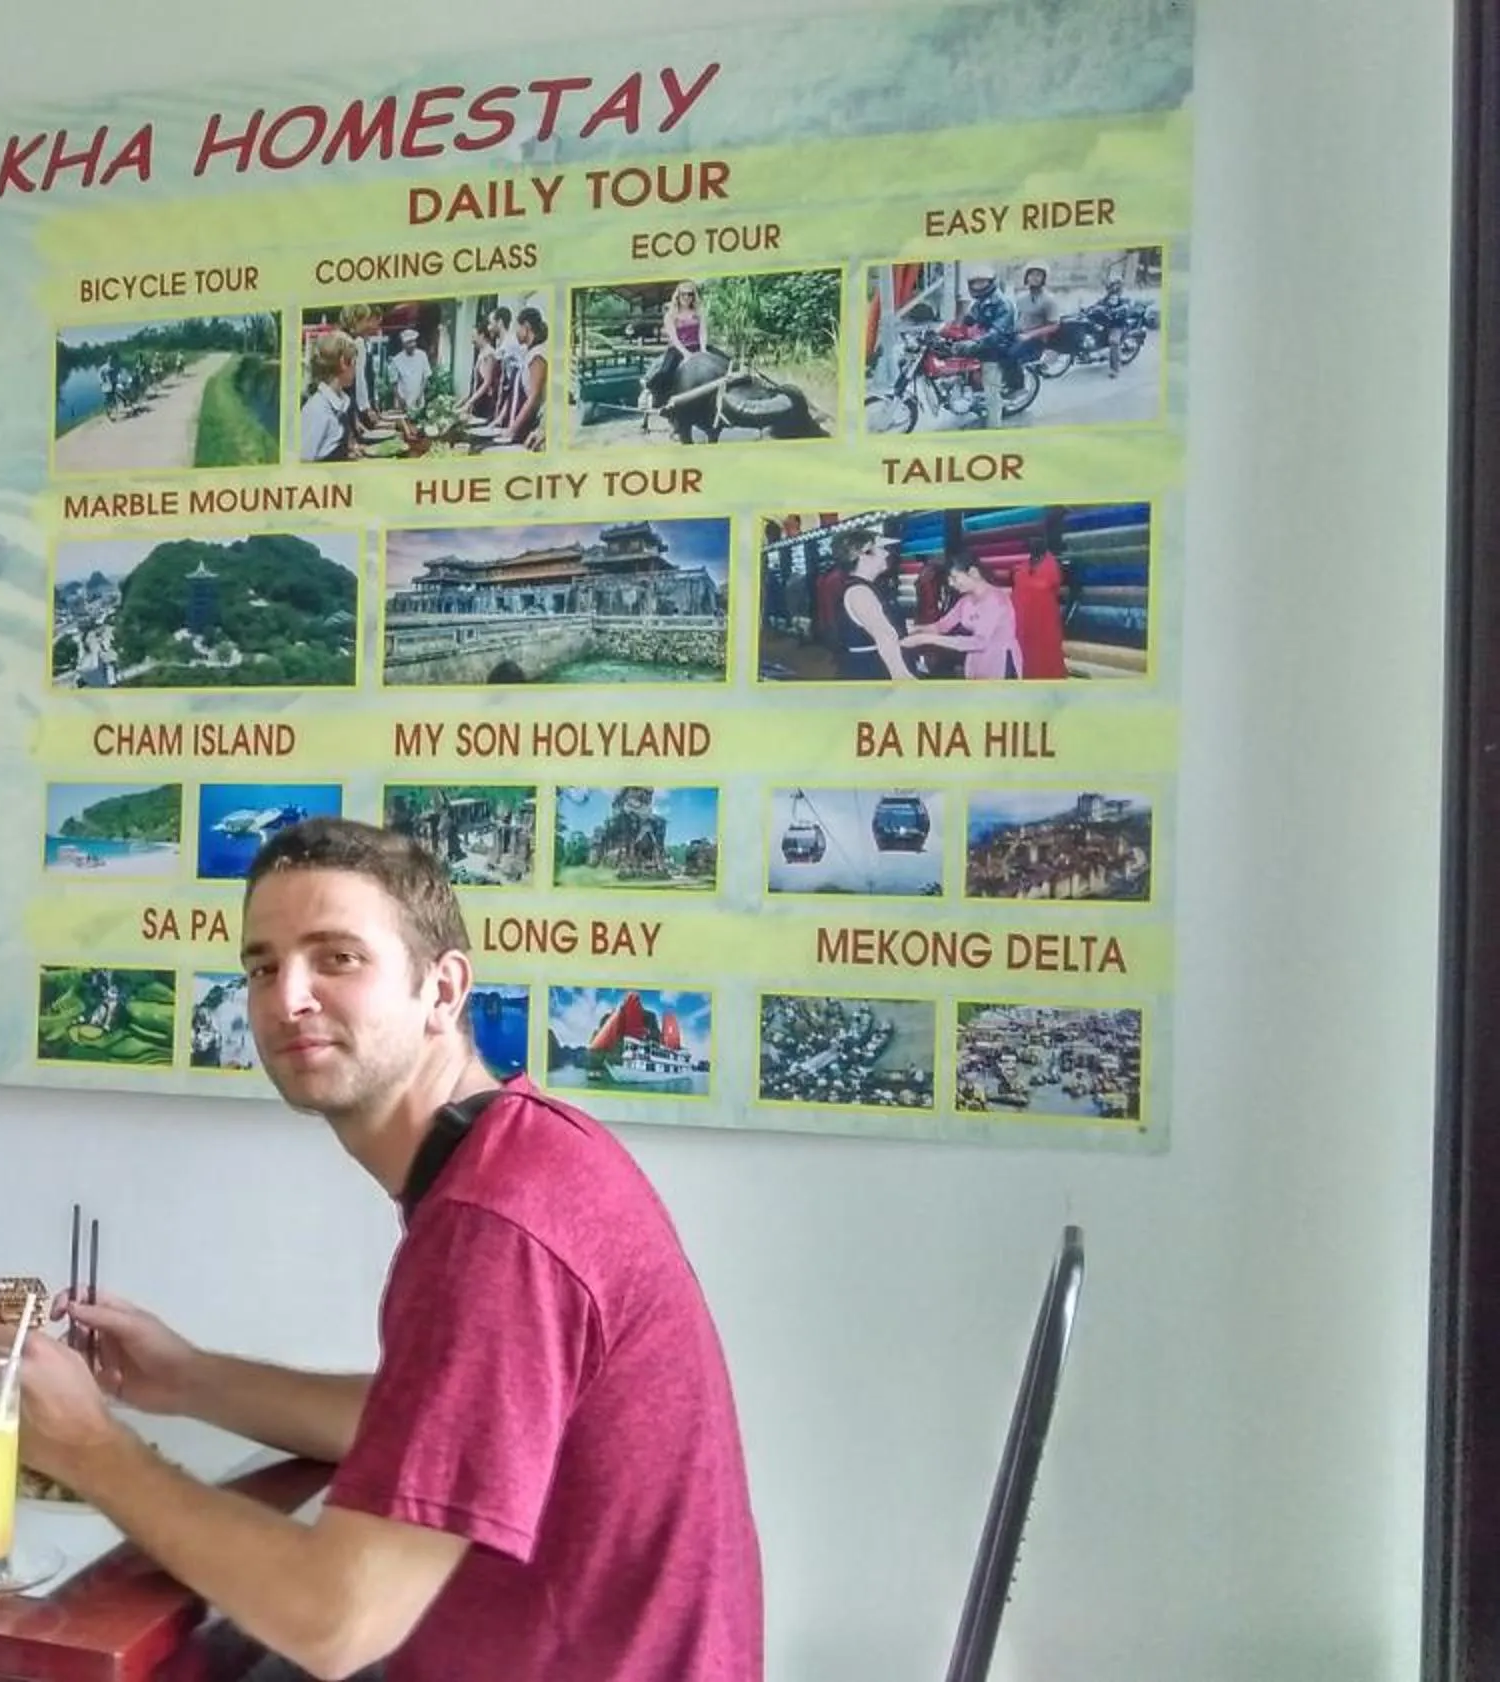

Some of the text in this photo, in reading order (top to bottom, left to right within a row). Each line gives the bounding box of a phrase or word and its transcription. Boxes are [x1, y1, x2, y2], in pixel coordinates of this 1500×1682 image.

[193, 63, 720, 177] HOMESTAY
[408, 161, 731, 225] DAILY TOUR
[925, 198, 1116, 237] EASY RIDER
[631, 224, 781, 260] ECO TOUR
[316, 243, 538, 284] COOKING CLASS
[80, 266, 259, 303] BICYCLE TOUR
[415, 468, 703, 505] HUE CITY TOUR
[882, 453, 1024, 484] TAILOR
[64, 484, 354, 519] MARBLE MOUNTAIN
[93, 723, 296, 756] CHAM ISLAND
[395, 721, 711, 757] MY SON HOLYLAND
[856, 721, 1056, 758] BA NA HILL
[142, 908, 230, 942] SA PA
[483, 917, 663, 957] LONG BAY
[816, 927, 1127, 974] MEKONG DELTA
